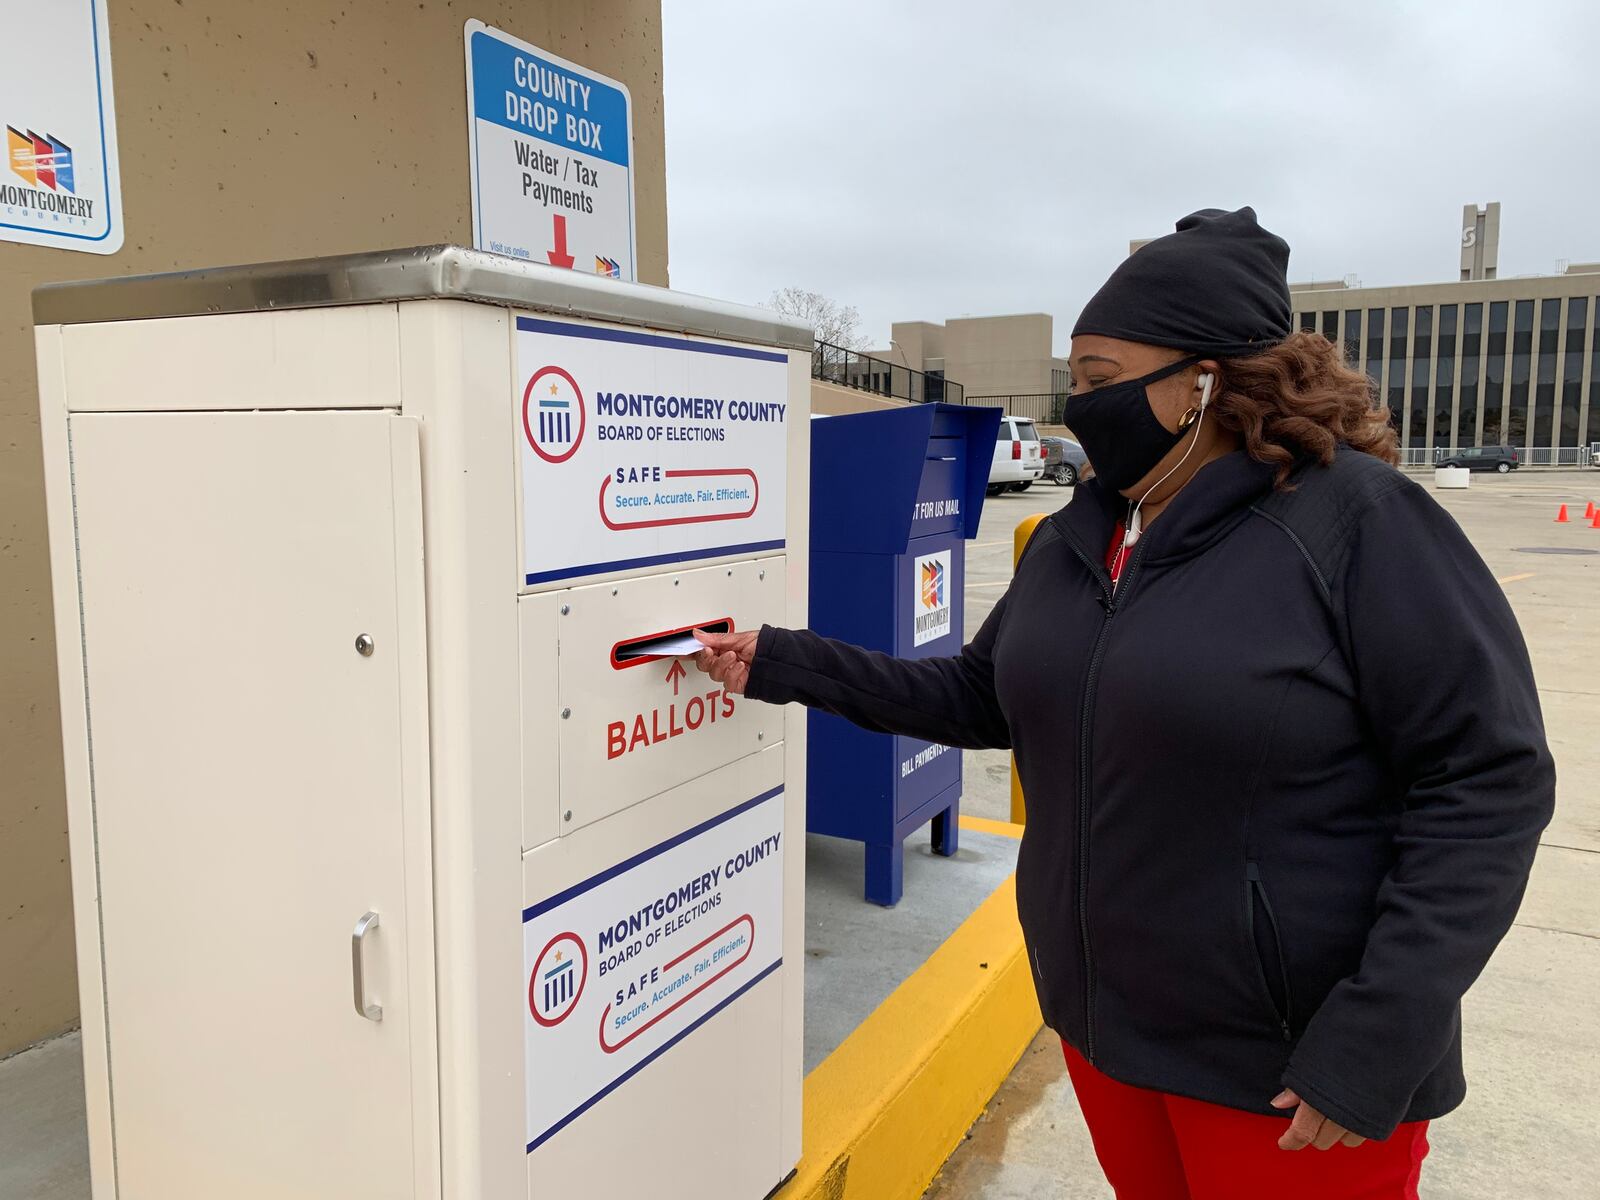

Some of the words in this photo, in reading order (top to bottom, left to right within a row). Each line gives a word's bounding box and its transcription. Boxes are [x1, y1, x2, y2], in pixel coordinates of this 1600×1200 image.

[514, 56, 591, 112] COUNTY
[505, 90, 559, 135] DROP
[565, 113, 603, 152] BOX
[514, 139, 559, 177] Water
[563, 156, 570, 182] /
[573, 159, 599, 189] Tax
[522, 172, 594, 214] Payments
[7, 206, 87, 226] COUNTY
[489, 240, 503, 252] Visit
[504, 244, 512, 254] us
[513, 246, 530, 259] online
[596, 392, 725, 420] MONTGOMERY
[728, 400, 786, 423] COUNTY
[598, 425, 643, 441] BOARD
[646, 426, 663, 441] OF
[666, 426, 725, 442] ELECTIONS
[616, 466, 661, 484] SAFE
[615, 495, 652, 508] Secure.
[653, 491, 695, 506] Accurate.
[697, 490, 714, 502] Fair.
[716, 488, 750, 501] Efficient.
[920, 501, 935, 520] FOR
[934, 500, 945, 518] US
[944, 499, 960, 516] MAIL
[607, 688, 735, 761] BALLOTS
[901, 758, 915, 778] BILL
[915, 743, 943, 770] PAYMENTS
[598, 865, 722, 954] MONTGOMERY
[724, 832, 782, 879] COUNTY
[598, 943, 643, 977] BOARD
[645, 928, 662, 948] OF
[664, 892, 722, 938] ELECTIONS
[614, 1001, 650, 1030] Secure.
[651, 970, 692, 1006] Accurate.
[693, 957, 711, 978] Fair.
[712, 934, 747, 964] Efficient.
[615, 966, 660, 1006] SAFE
